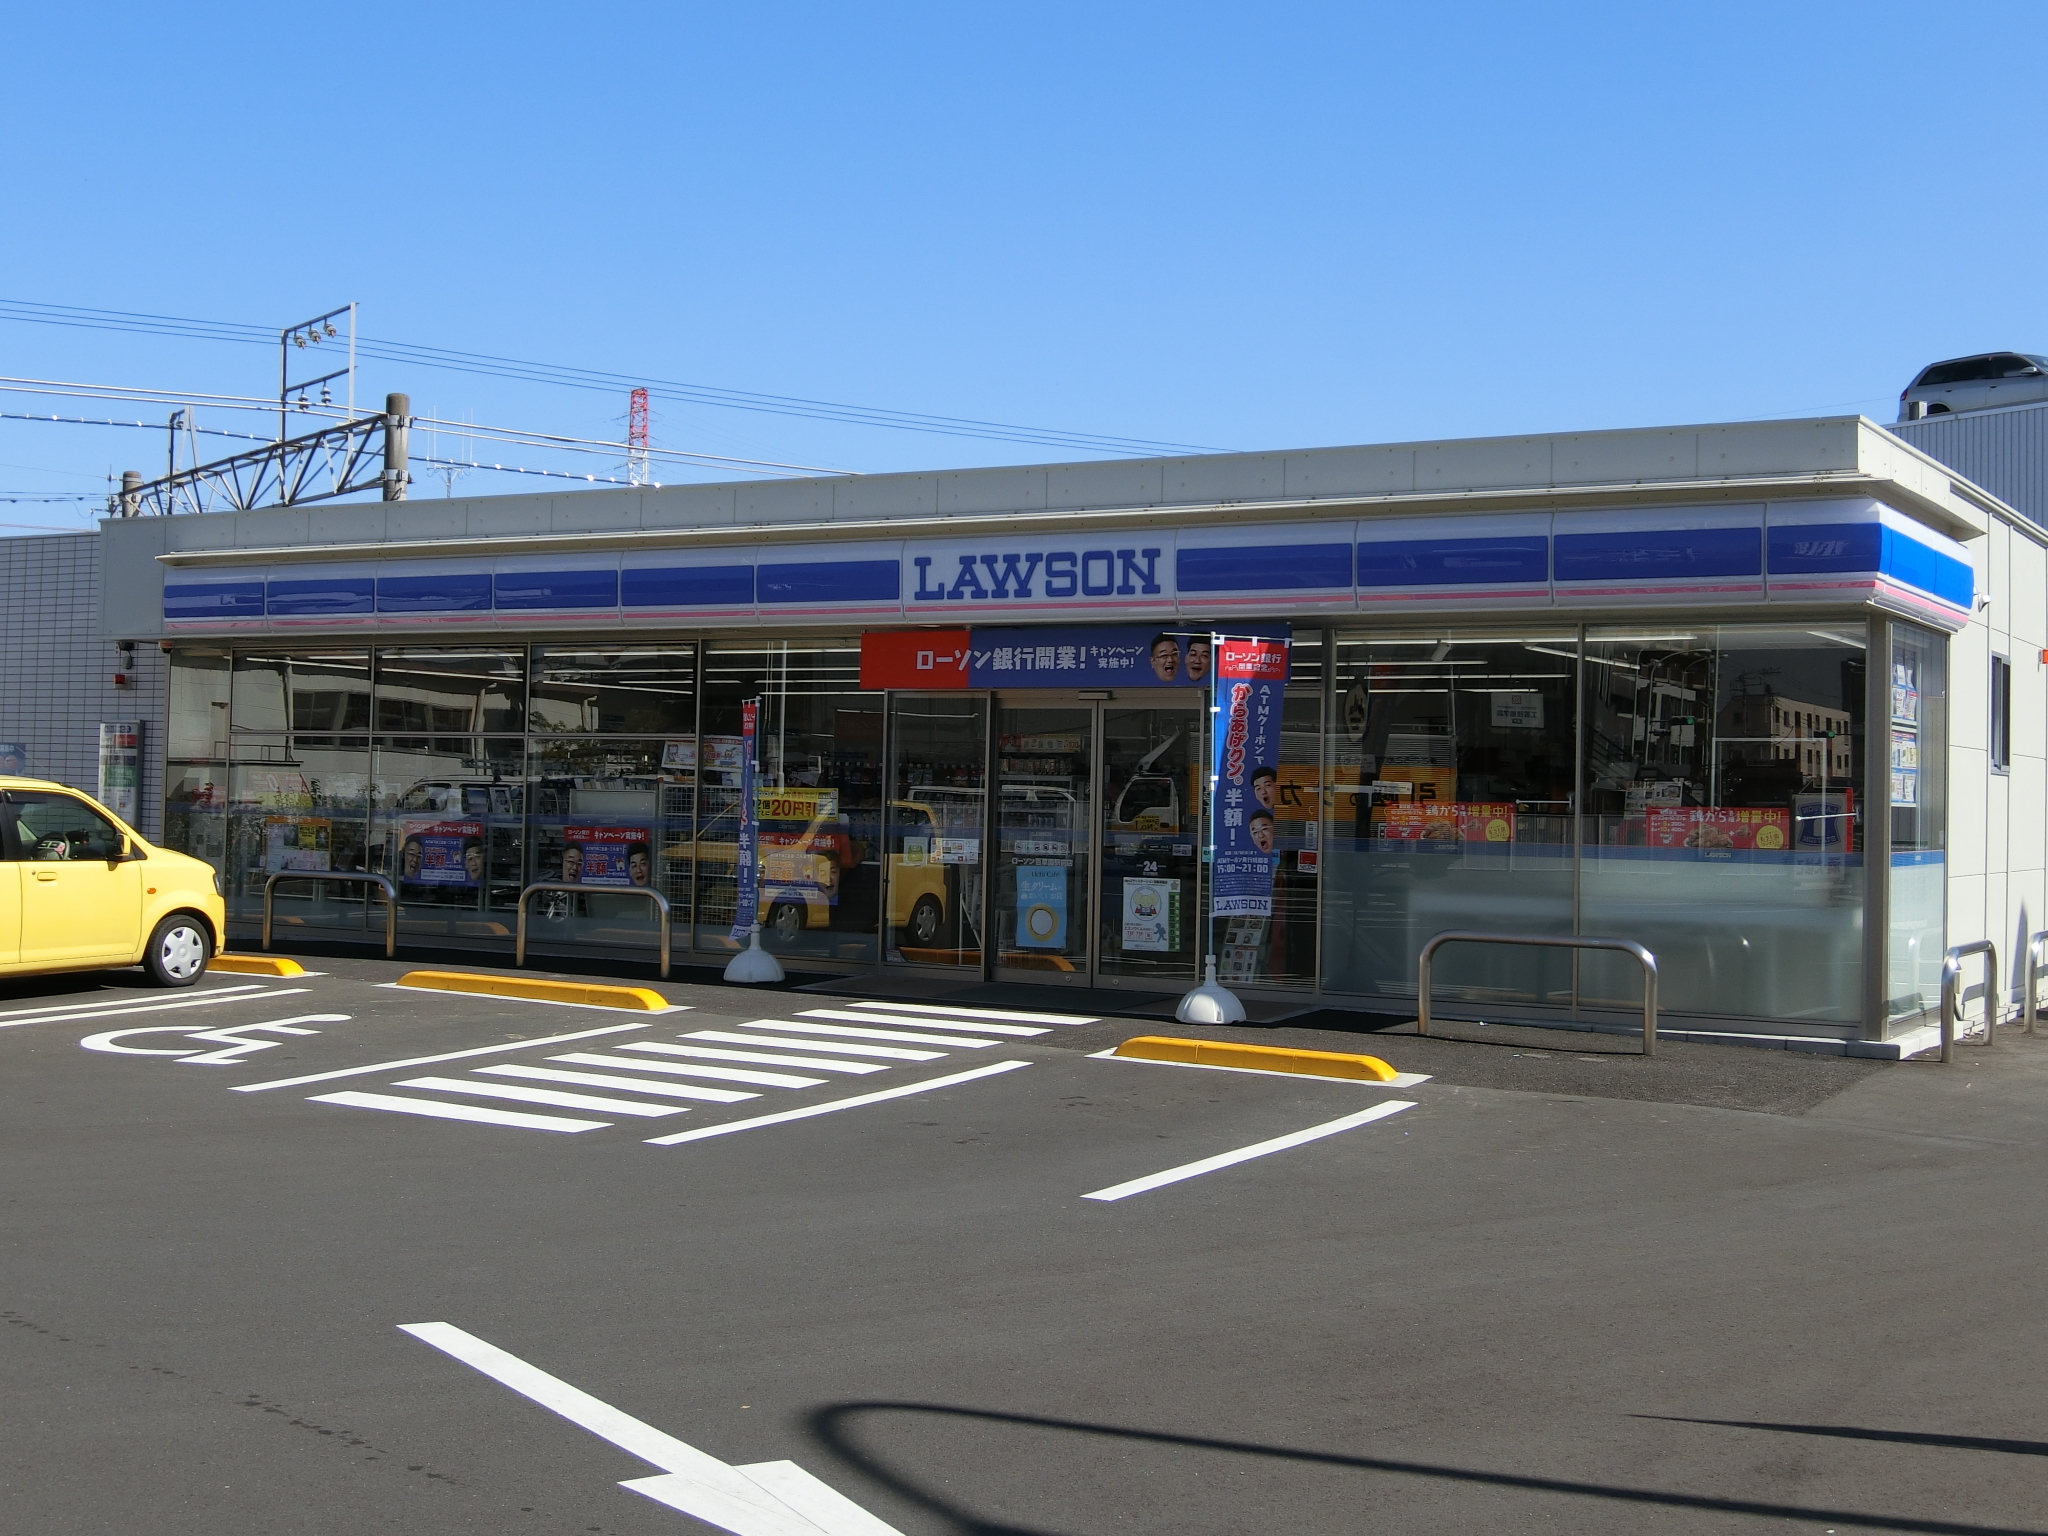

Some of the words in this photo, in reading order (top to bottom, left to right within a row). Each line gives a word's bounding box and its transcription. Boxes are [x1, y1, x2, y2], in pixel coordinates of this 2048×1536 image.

[914, 548, 1161, 600] LAWSON
[1089, 645, 1144, 657] キャンペーン
[916, 647, 1086, 671] ローソン銀行開業!
[1097, 657, 1135, 669] 実施中!
[1225, 652, 1282, 664] ローソン銀行
[772, 799, 818, 817] 20円引
[585, 860, 608, 876] 半額
[1143, 860, 1158, 872] 24
[1215, 898, 1269, 911] LAWSON
